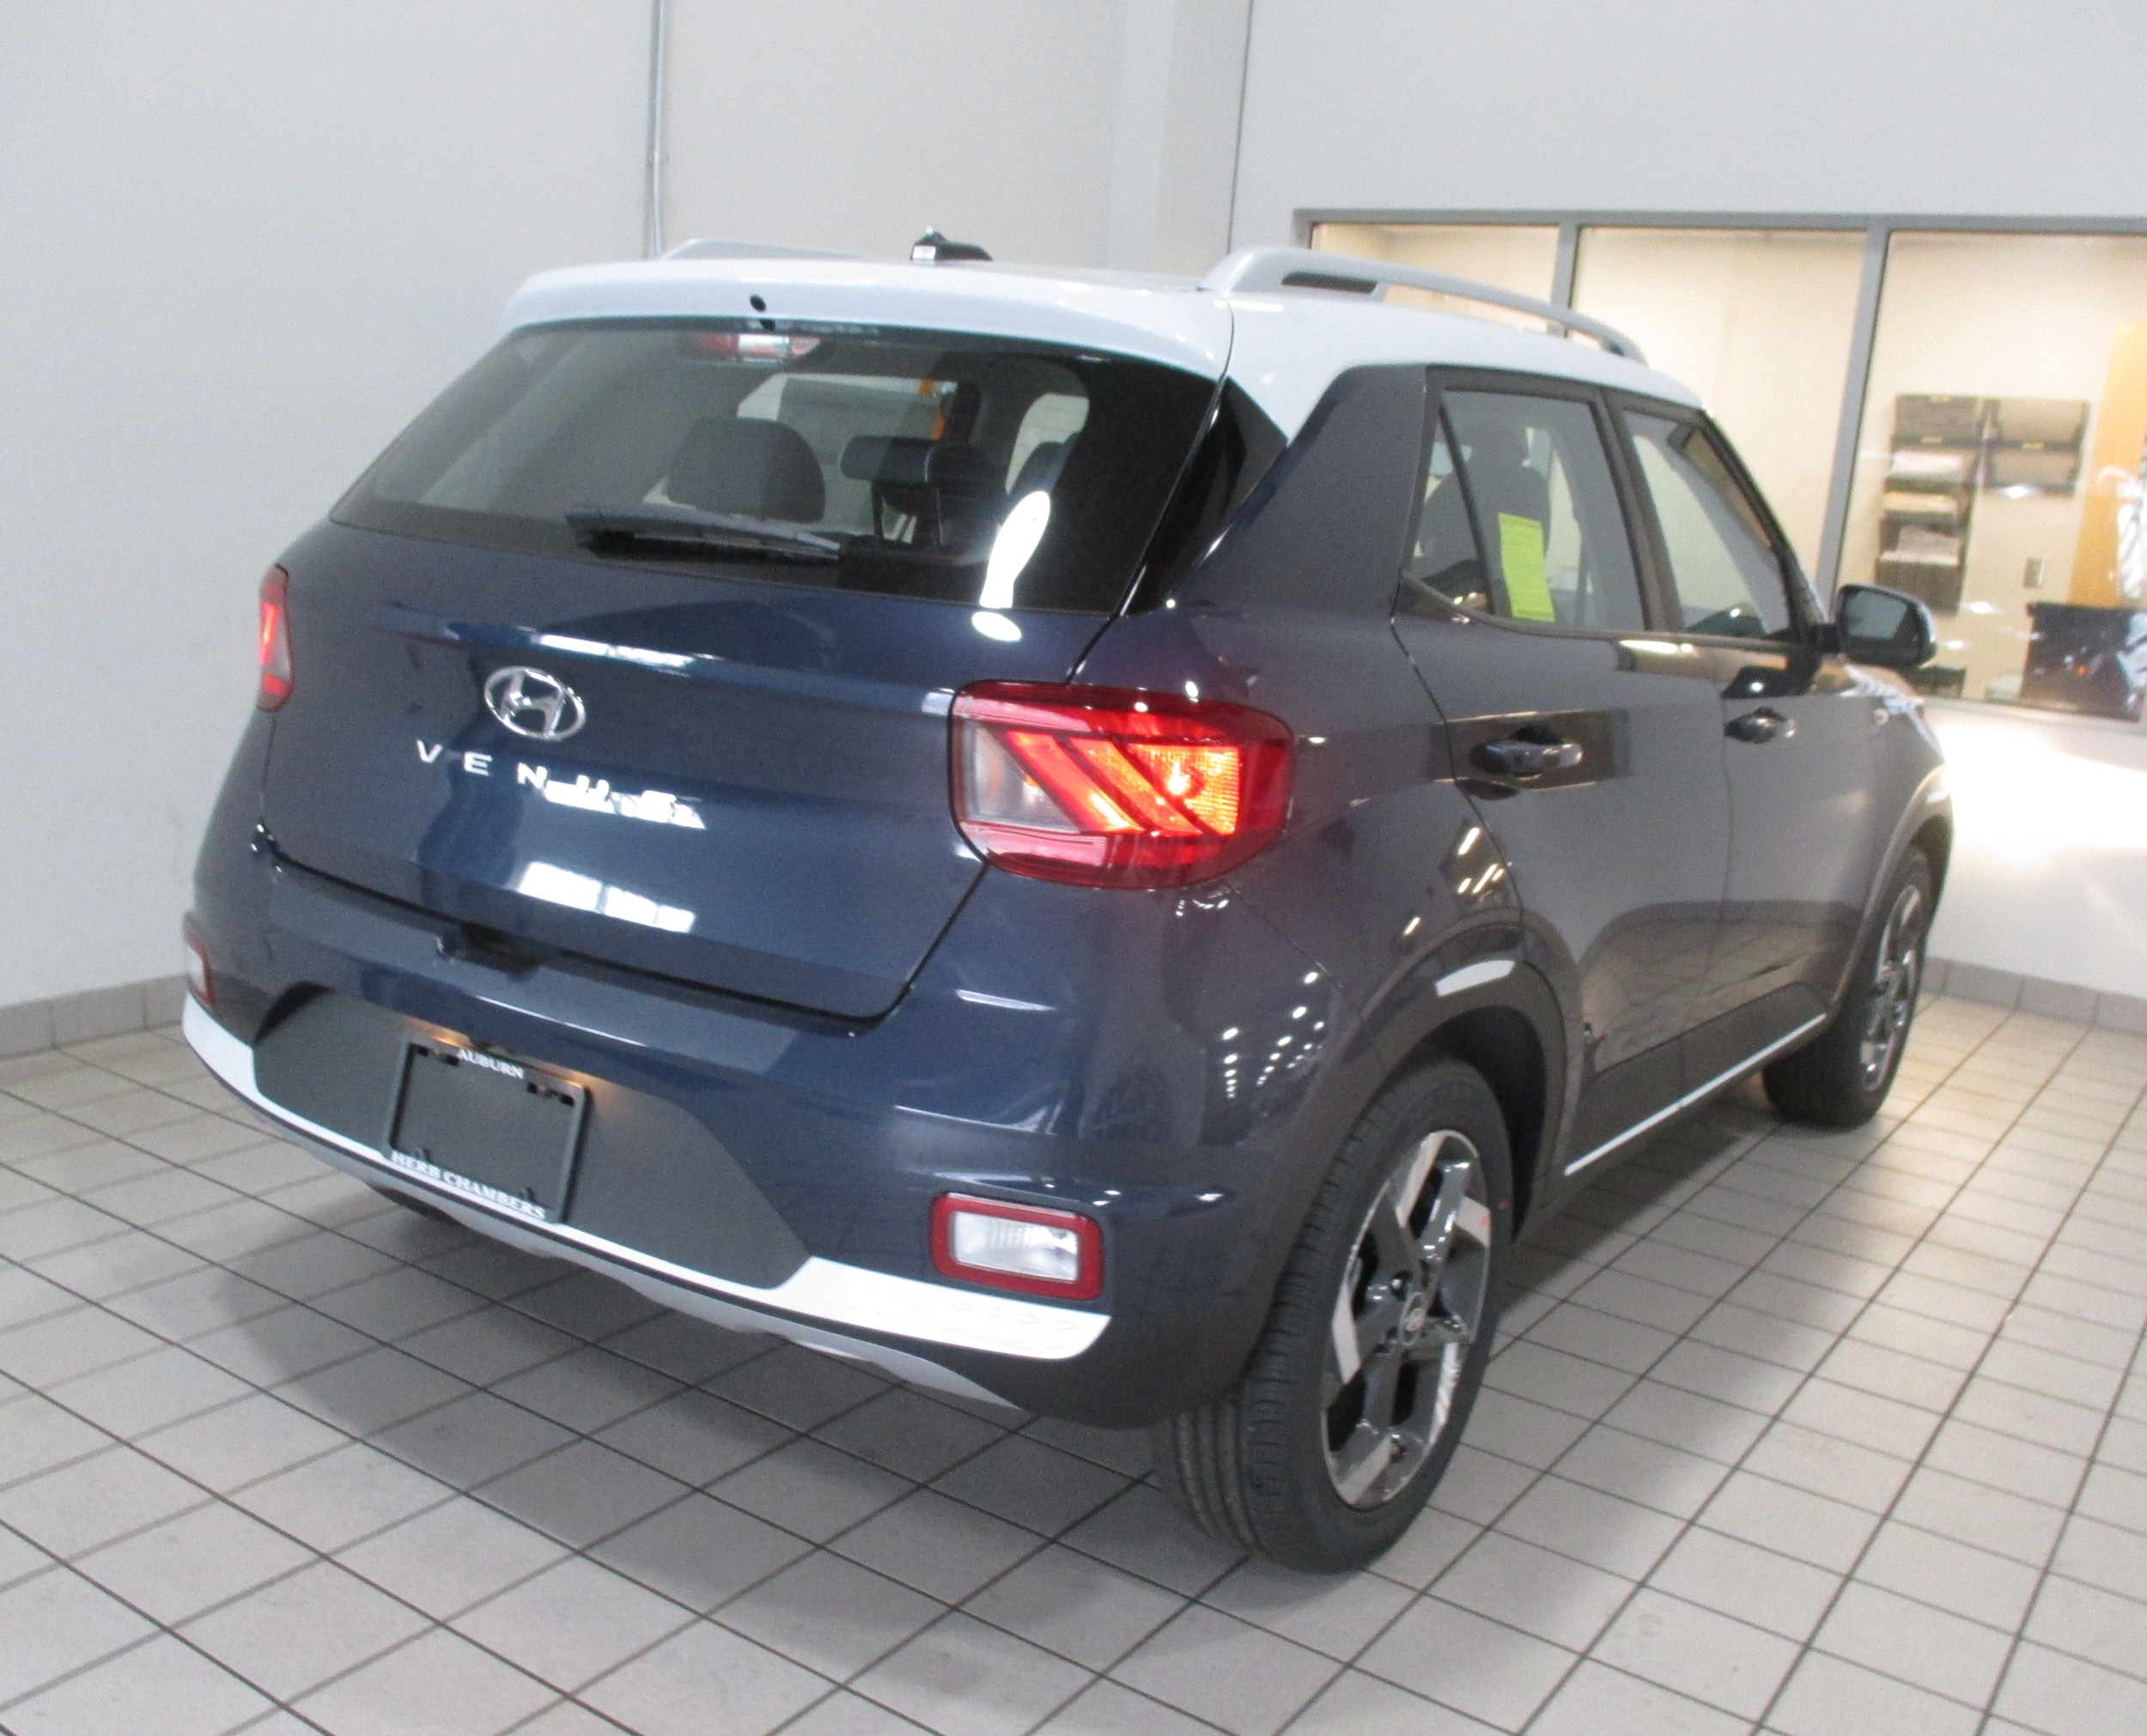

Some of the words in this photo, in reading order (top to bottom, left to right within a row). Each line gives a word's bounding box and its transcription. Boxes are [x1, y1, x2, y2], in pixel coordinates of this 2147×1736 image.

[456, 1047, 525, 1080] AUBURN
[391, 1150, 441, 1181] HERB
[442, 1170, 547, 1220] CHAMBERS
